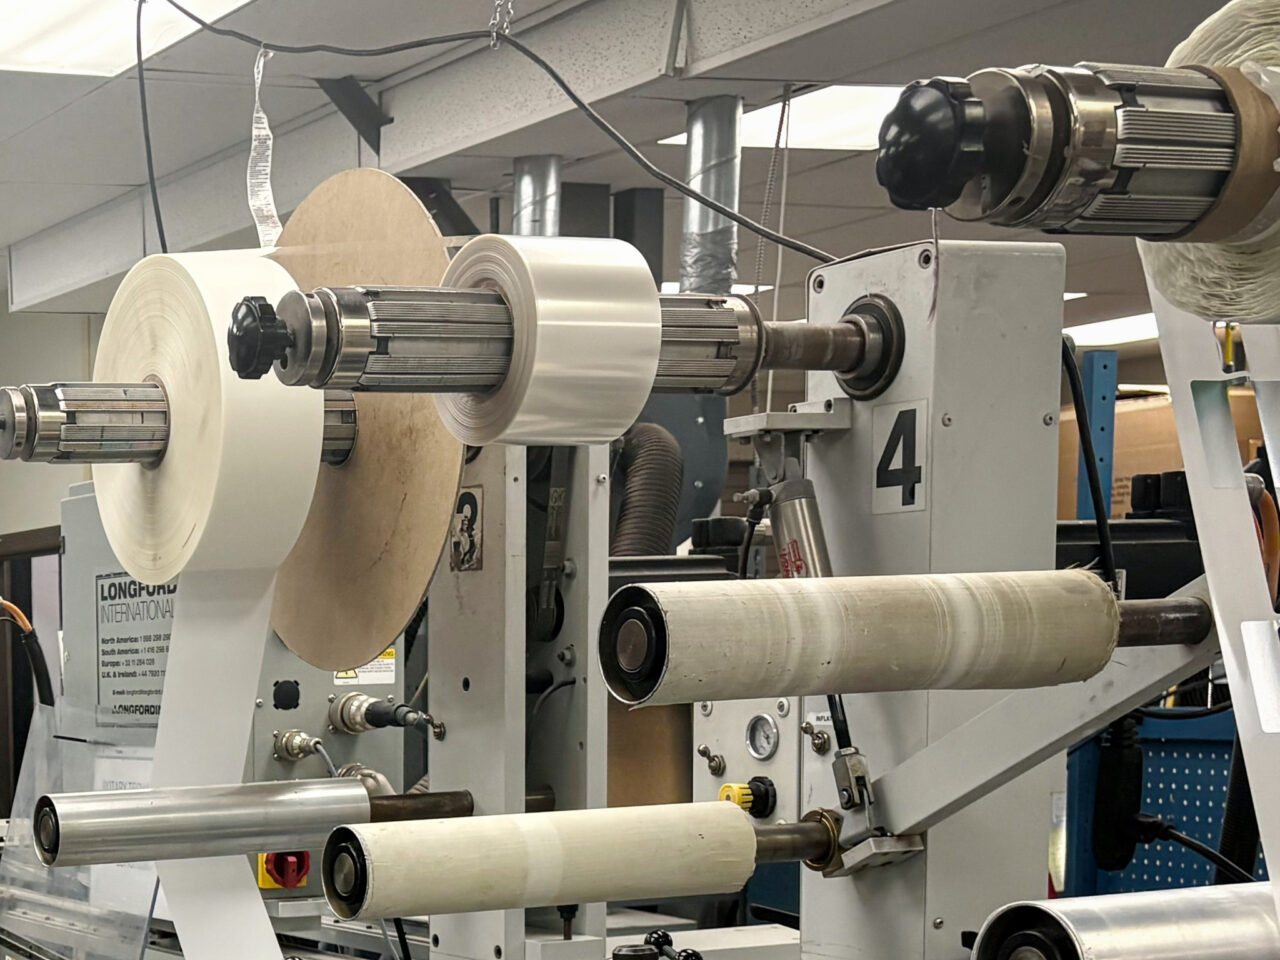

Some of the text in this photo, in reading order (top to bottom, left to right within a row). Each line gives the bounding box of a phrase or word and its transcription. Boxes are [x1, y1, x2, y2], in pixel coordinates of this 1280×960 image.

[876, 408, 922, 506] 4
[100, 580, 177, 601] LONGFORD
[101, 598, 174, 624] INTERNATIONAL
